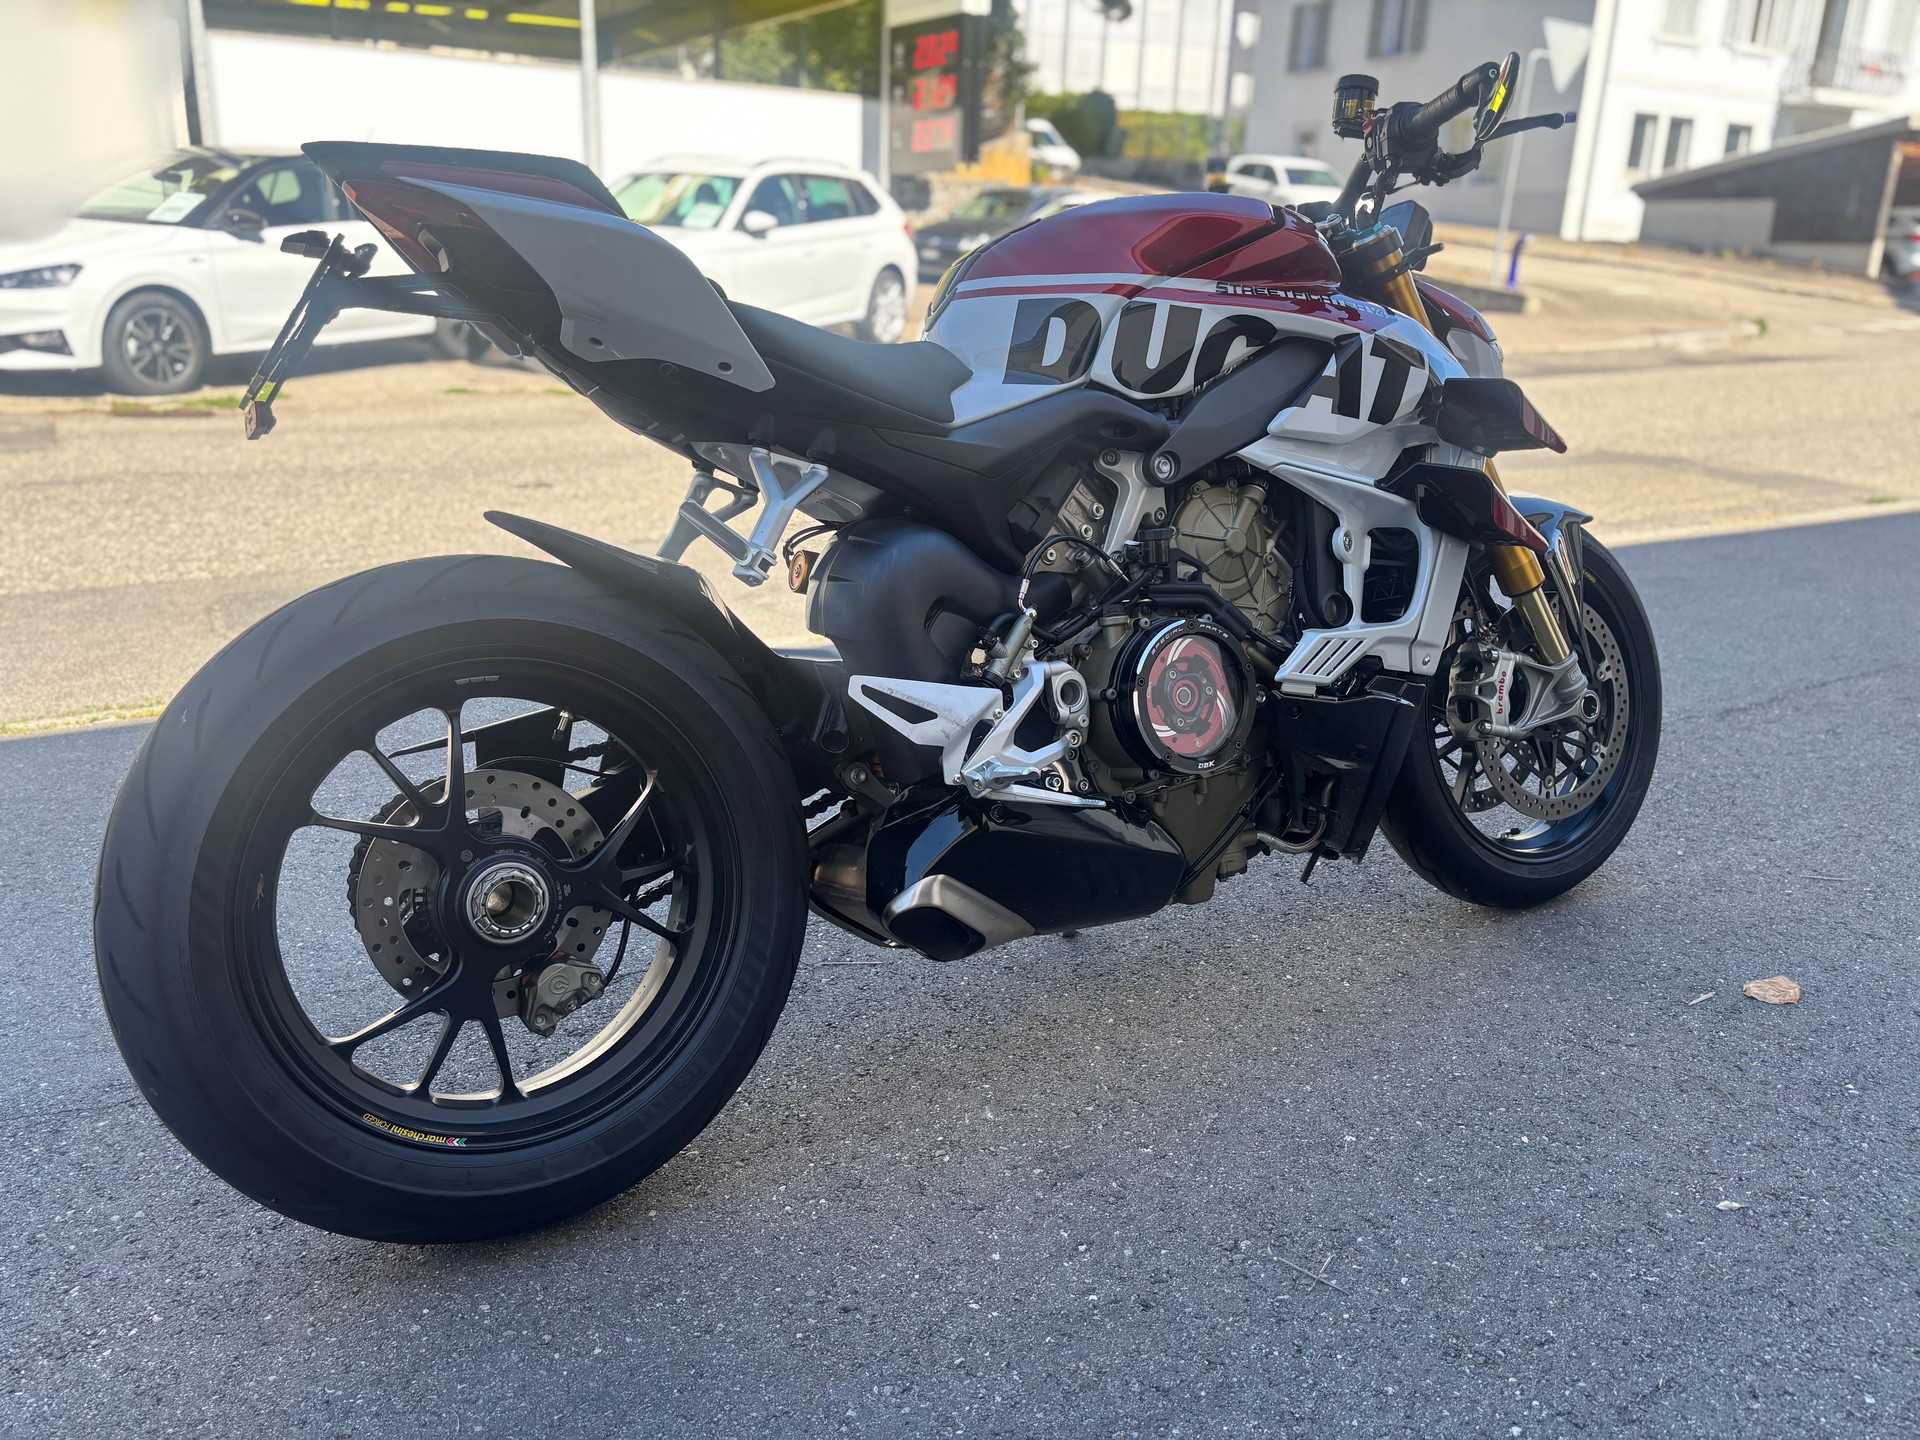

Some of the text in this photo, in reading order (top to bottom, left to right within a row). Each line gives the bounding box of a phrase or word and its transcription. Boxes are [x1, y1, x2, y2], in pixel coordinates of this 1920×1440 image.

[1151, 624, 1229, 655] SPECIAL PARTS
[1496, 670, 1507, 714] brembo
[1197, 759, 1215, 769] DBK
[362, 1113, 447, 1144] marchesini FORGED
